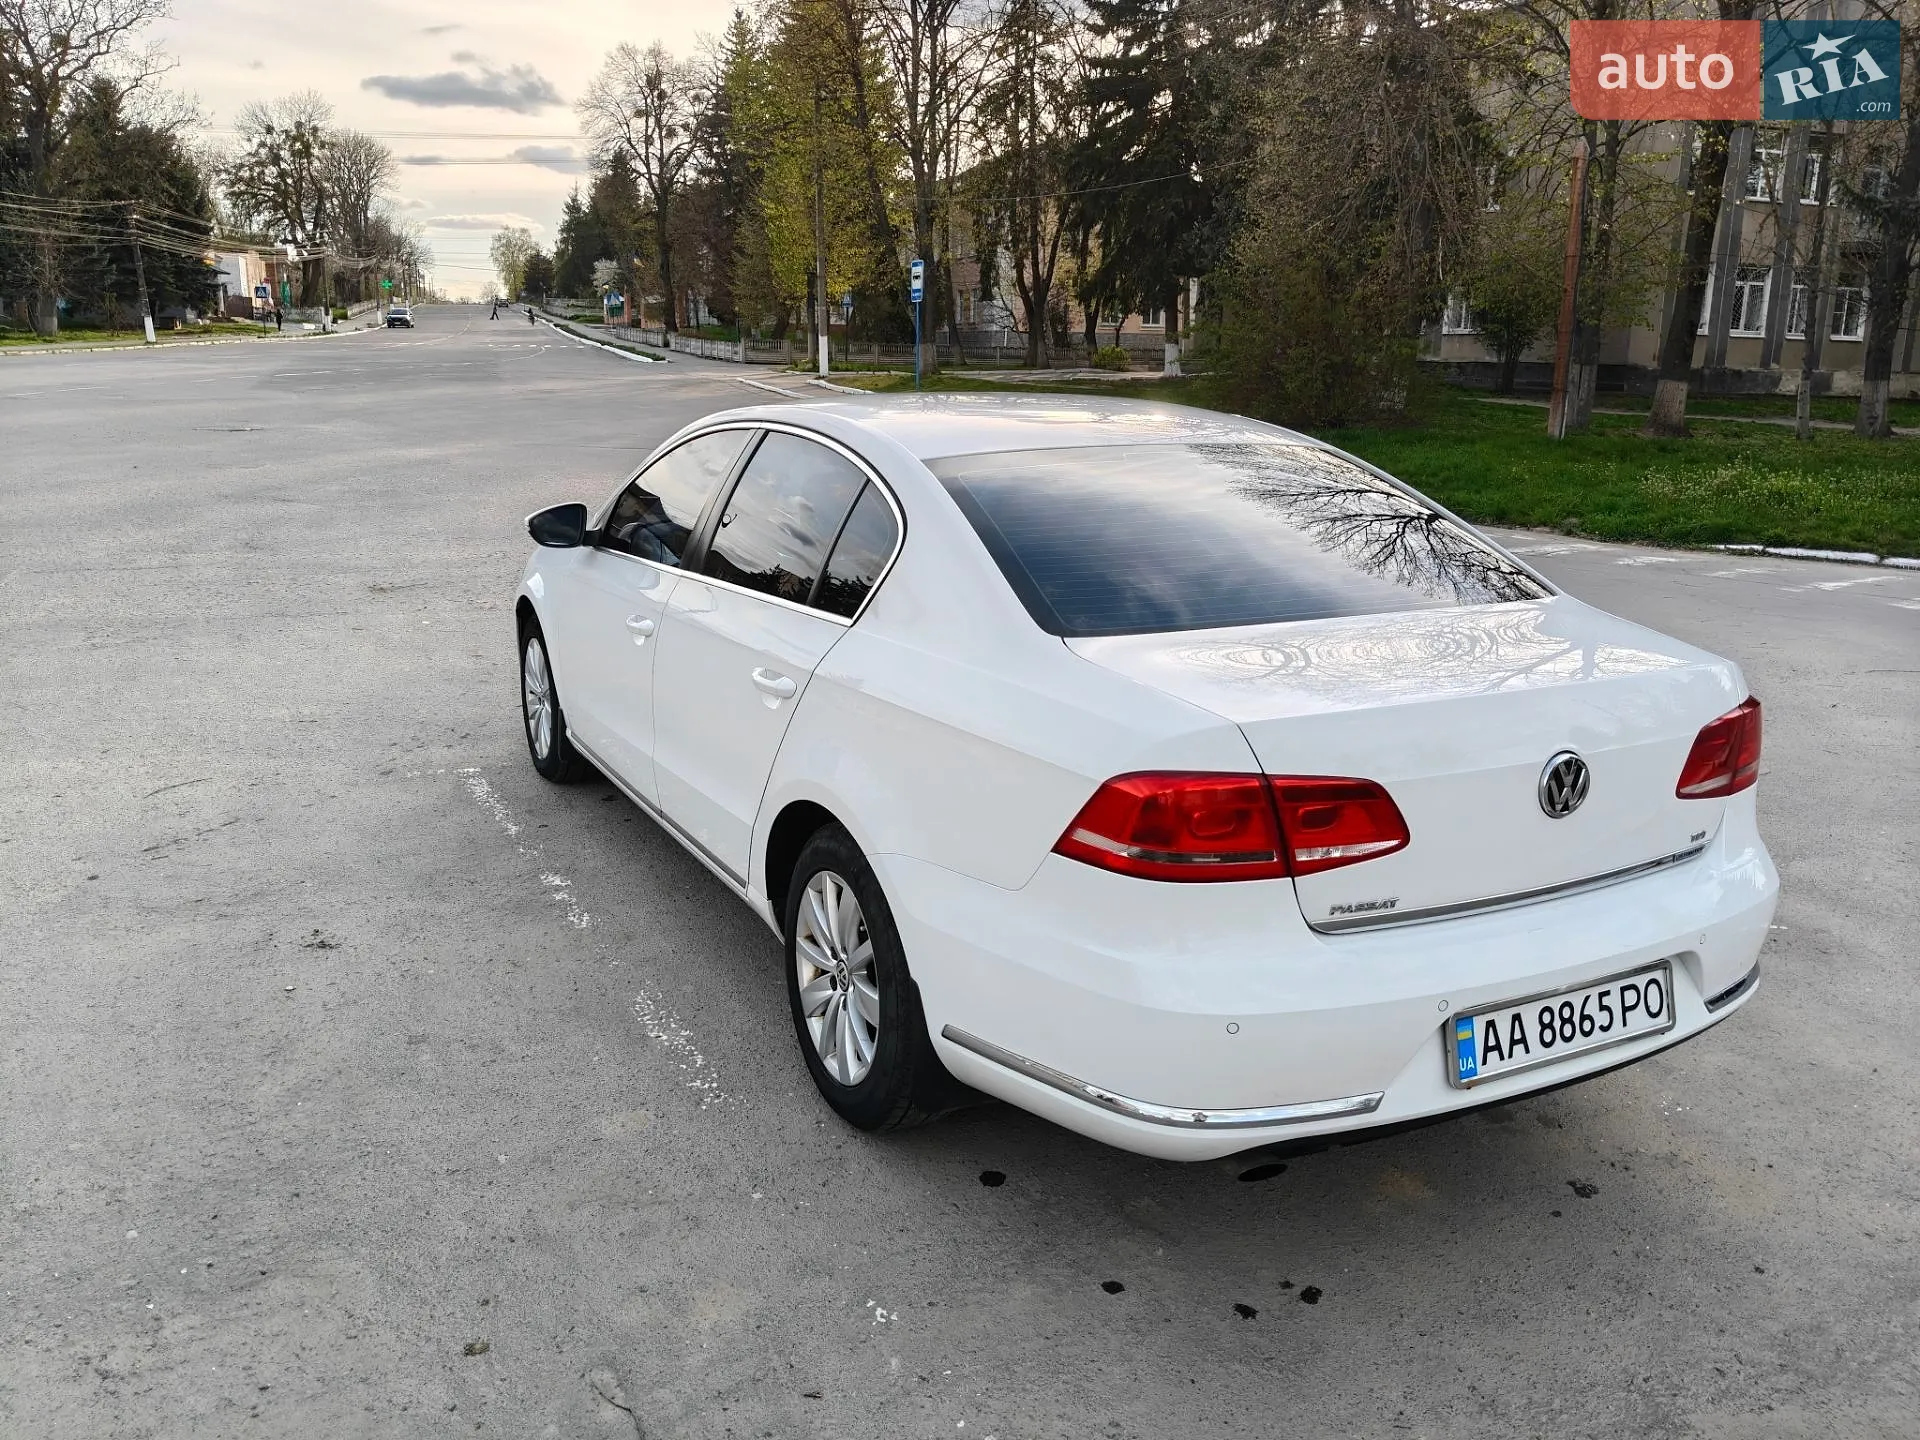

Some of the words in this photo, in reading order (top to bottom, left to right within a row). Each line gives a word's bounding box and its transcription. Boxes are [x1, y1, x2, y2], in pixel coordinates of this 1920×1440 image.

[1481, 1012, 1531, 1067] AA
[1538, 990, 1614, 1049] 8865
[1619, 977, 1664, 1028] PO
[1459, 1056, 1475, 1072] UA
